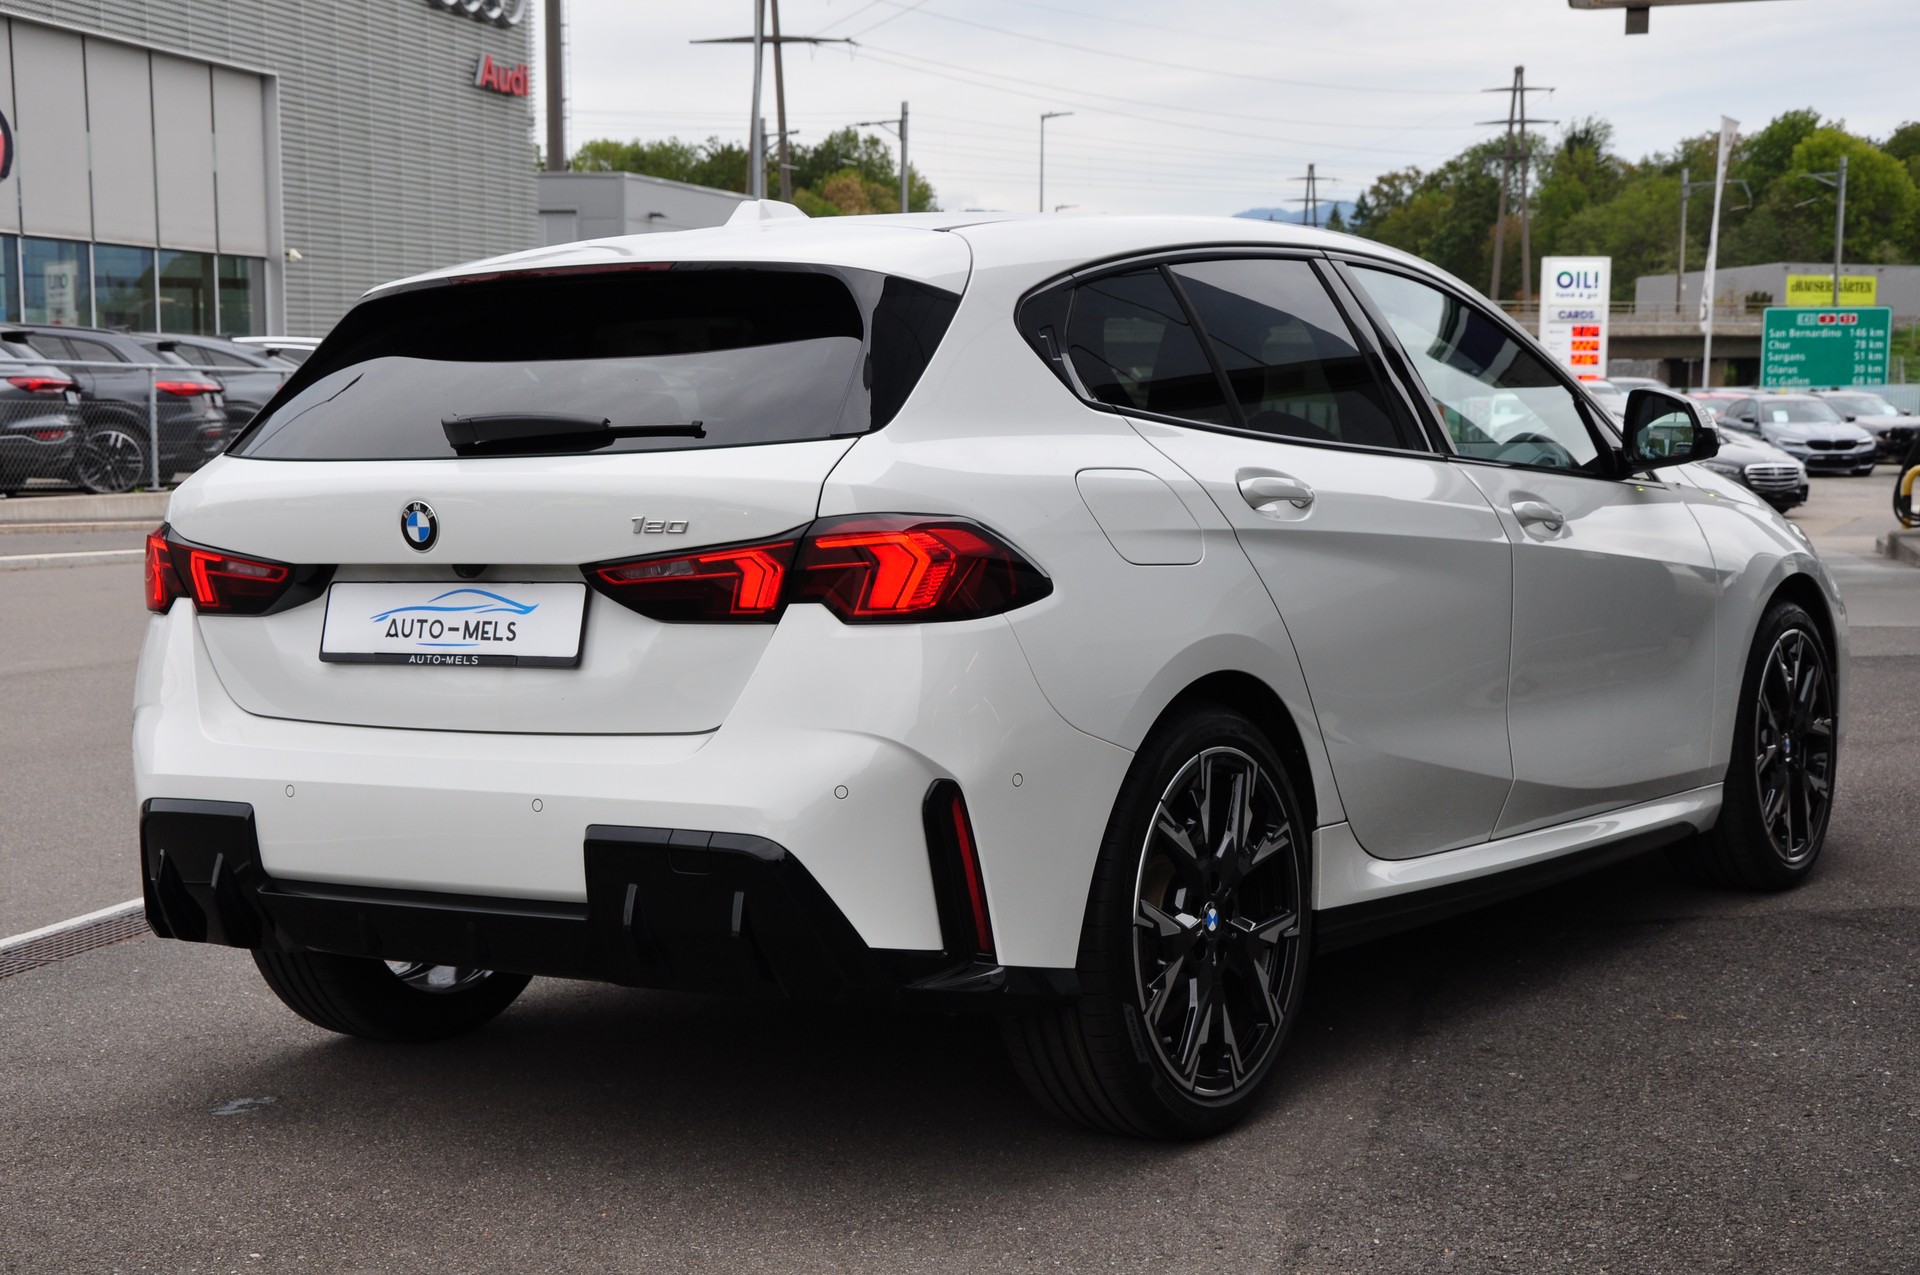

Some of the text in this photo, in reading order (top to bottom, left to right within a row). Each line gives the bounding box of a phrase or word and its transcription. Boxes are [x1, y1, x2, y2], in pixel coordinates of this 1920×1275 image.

[478, 52, 529, 97] Audi
[1557, 271, 1598, 288] OIL!
[1558, 310, 1594, 320] CARDS
[1768, 328, 1884, 338] San Bernardino 146 km
[1768, 339, 1884, 349] Chur 78 km
[1767, 351, 1883, 363] Sargans 51 km
[1767, 364, 1882, 374] Glarus 30 km
[1852, 376, 1865, 386] 68
[1867, 376, 1882, 386] km
[403, 502, 434, 519] BMW
[631, 516, 689, 534] 120
[385, 618, 517, 642] AUTO-MELS
[408, 654, 479, 665] AUTO-MELS
